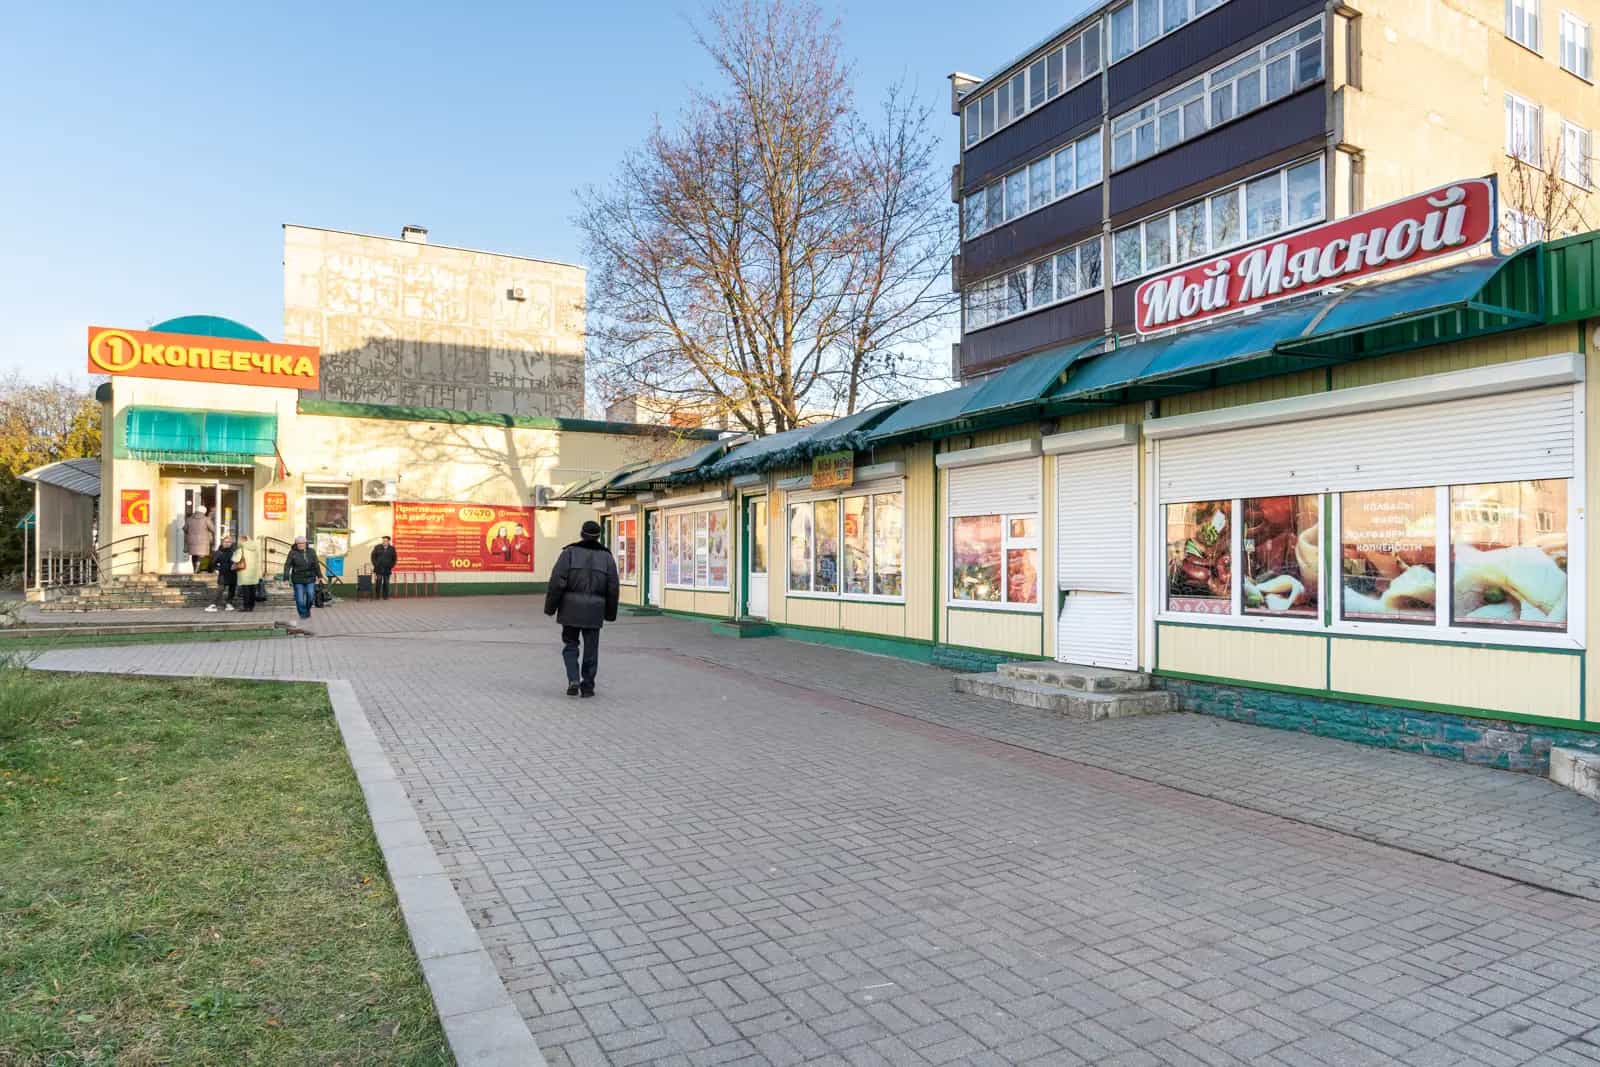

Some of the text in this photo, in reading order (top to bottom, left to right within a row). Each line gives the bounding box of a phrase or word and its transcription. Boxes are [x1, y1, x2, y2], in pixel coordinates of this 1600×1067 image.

[1142, 186, 1467, 328] Мой Мясной
[143, 343, 314, 377] КОПЕЕЧКА
[450, 559, 471, 568] 100
